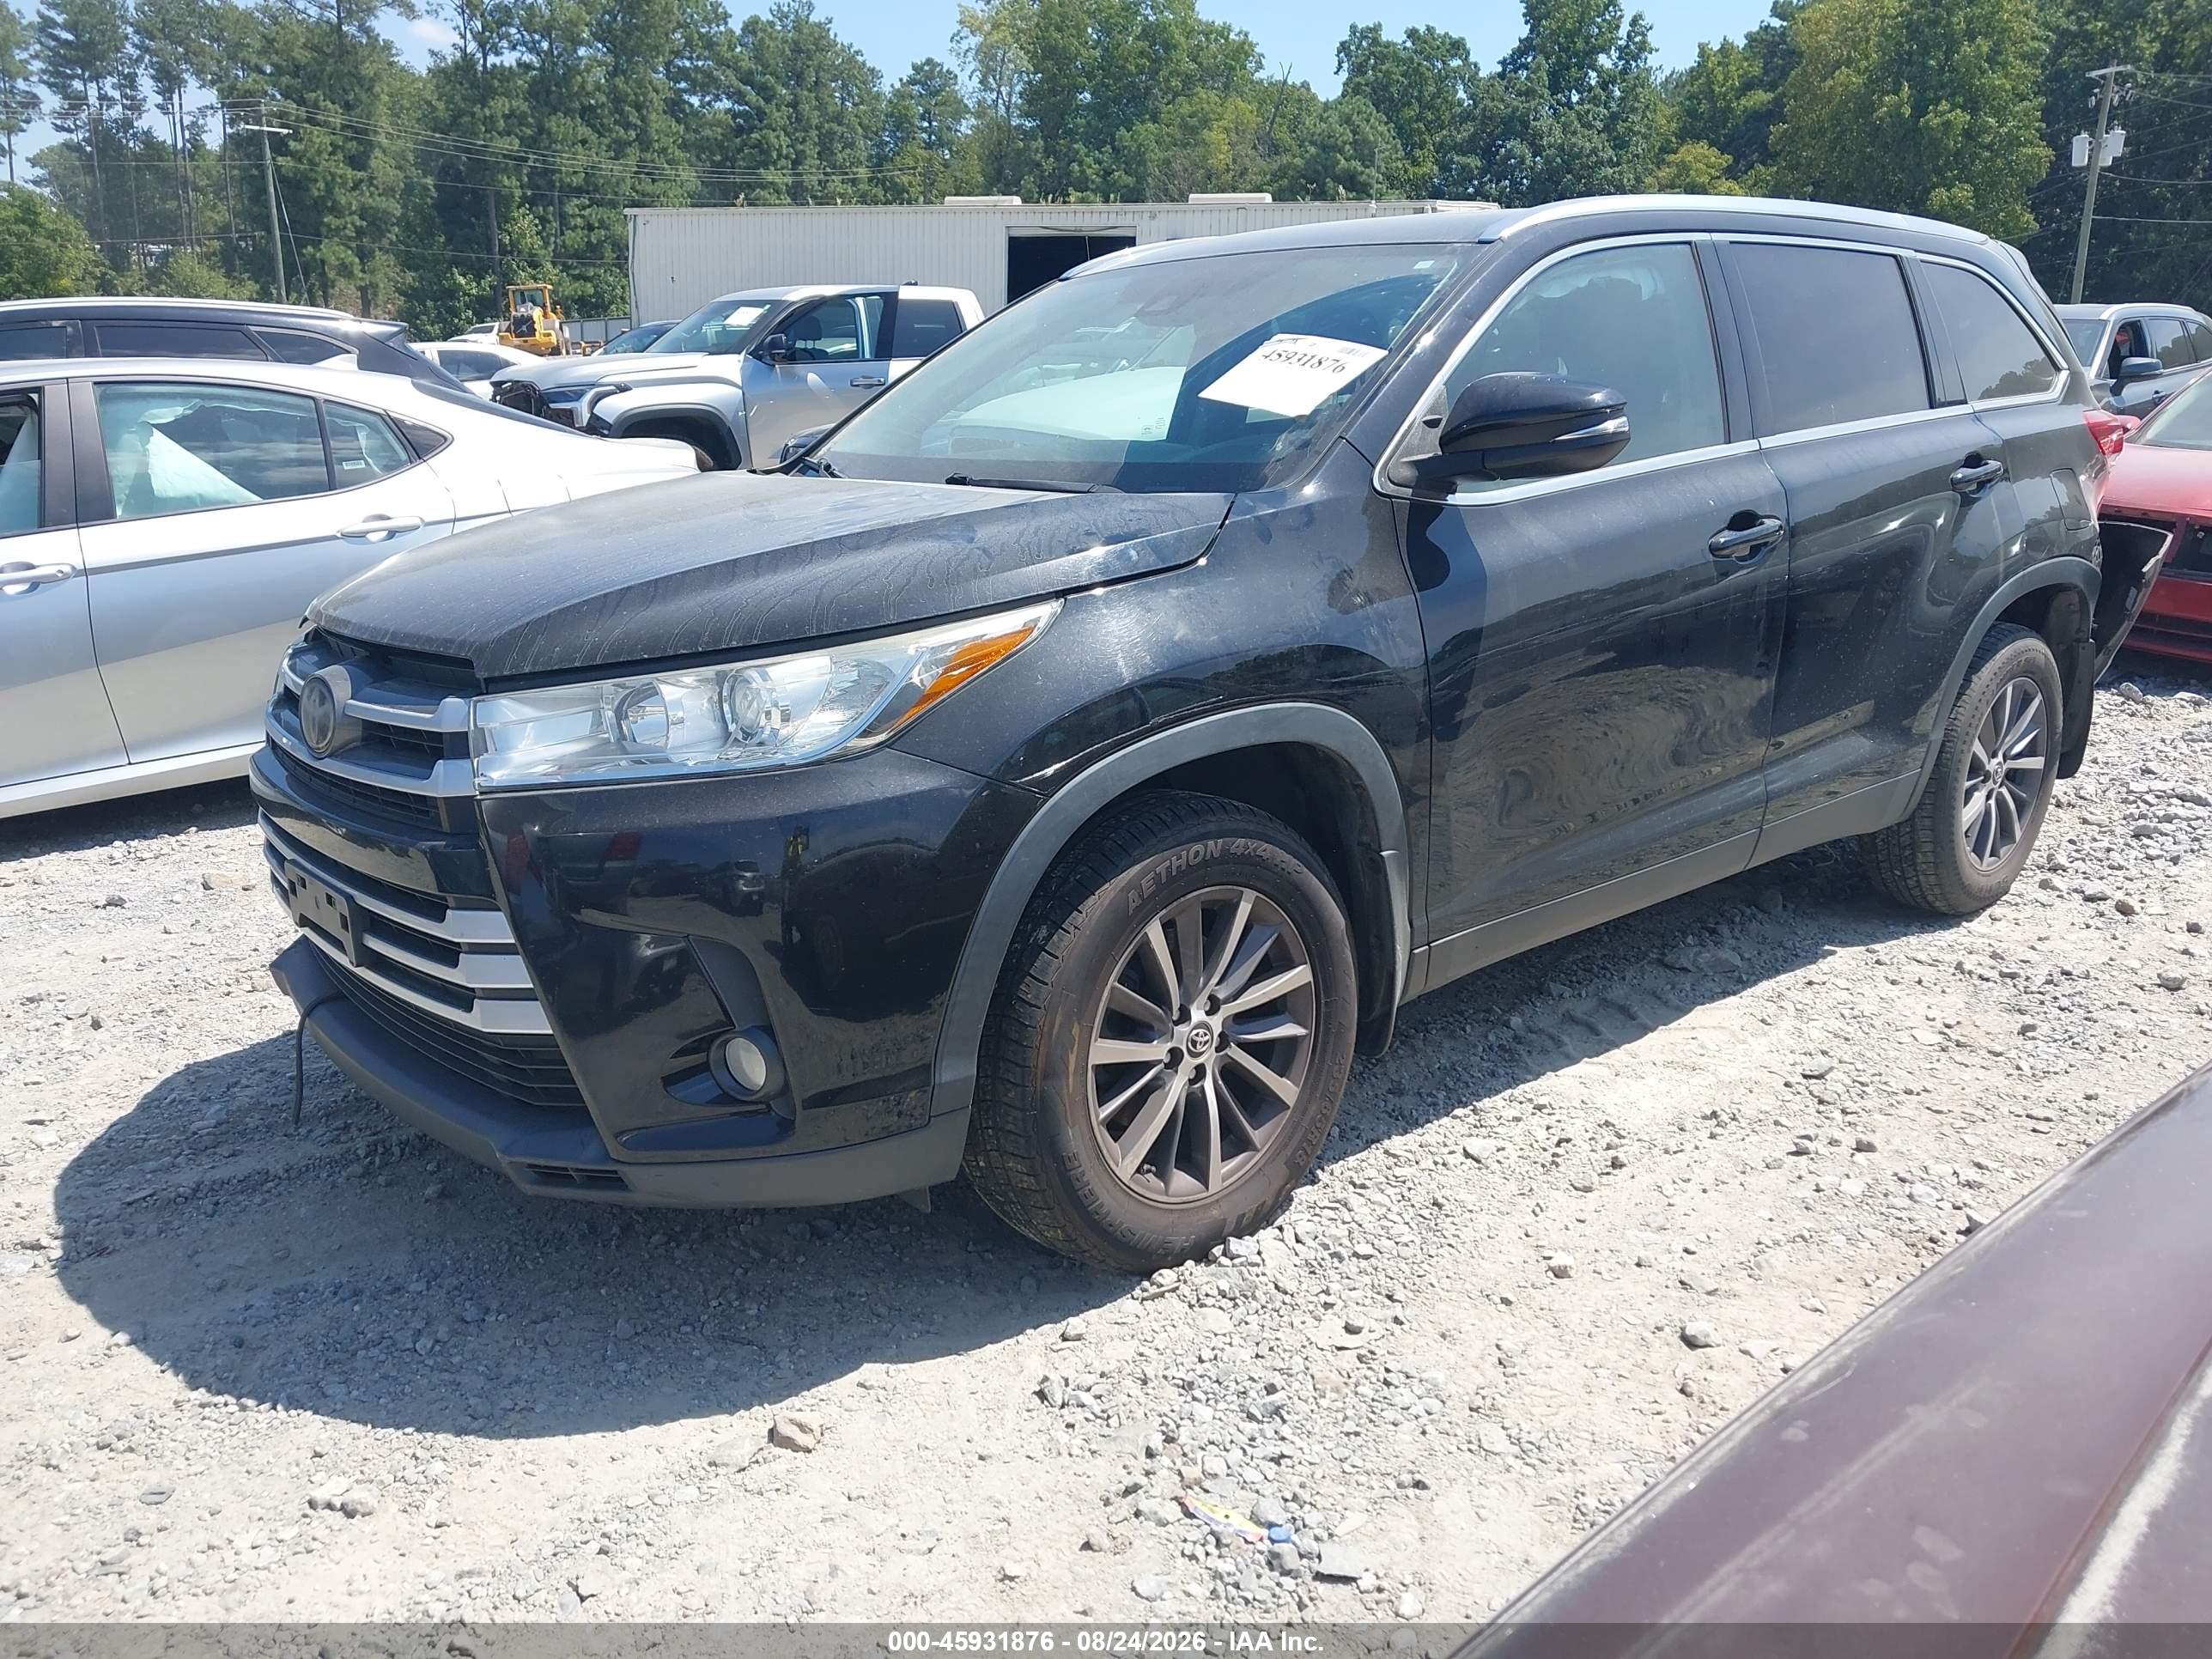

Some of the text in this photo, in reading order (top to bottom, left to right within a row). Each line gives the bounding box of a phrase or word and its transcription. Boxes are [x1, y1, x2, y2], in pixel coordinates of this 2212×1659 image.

[1261, 349, 1350, 374] 45931876
[1127, 839, 1224, 916] AETHON
[1061, 1150, 1196, 1261] HEMISPHERE
